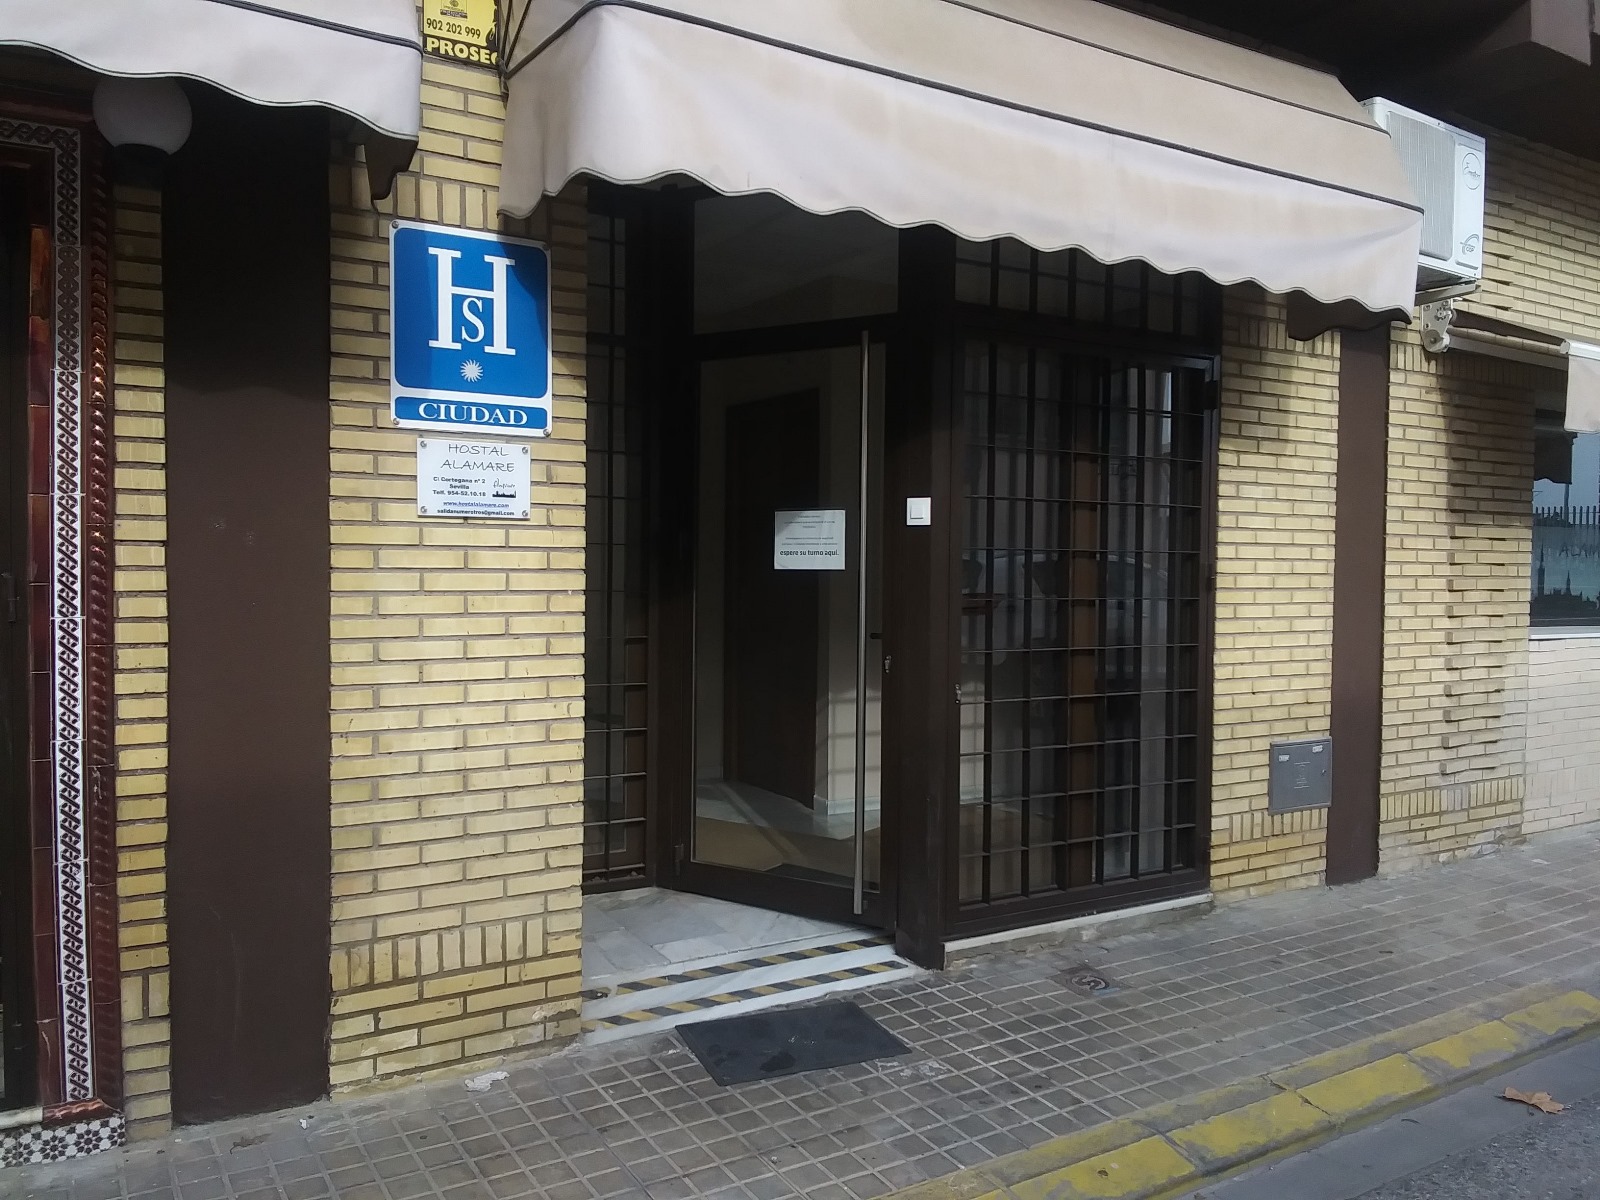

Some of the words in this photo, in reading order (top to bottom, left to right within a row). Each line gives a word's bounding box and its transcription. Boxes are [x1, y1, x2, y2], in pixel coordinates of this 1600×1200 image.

[426, 17, 443, 31] 902
[446, 21, 463, 35] 202
[464, 26, 481, 39] 999
[418, 402, 528, 426] CIUDAD
[448, 443, 509, 457] HOSTAL
[440, 459, 515, 472] ALAMARE
